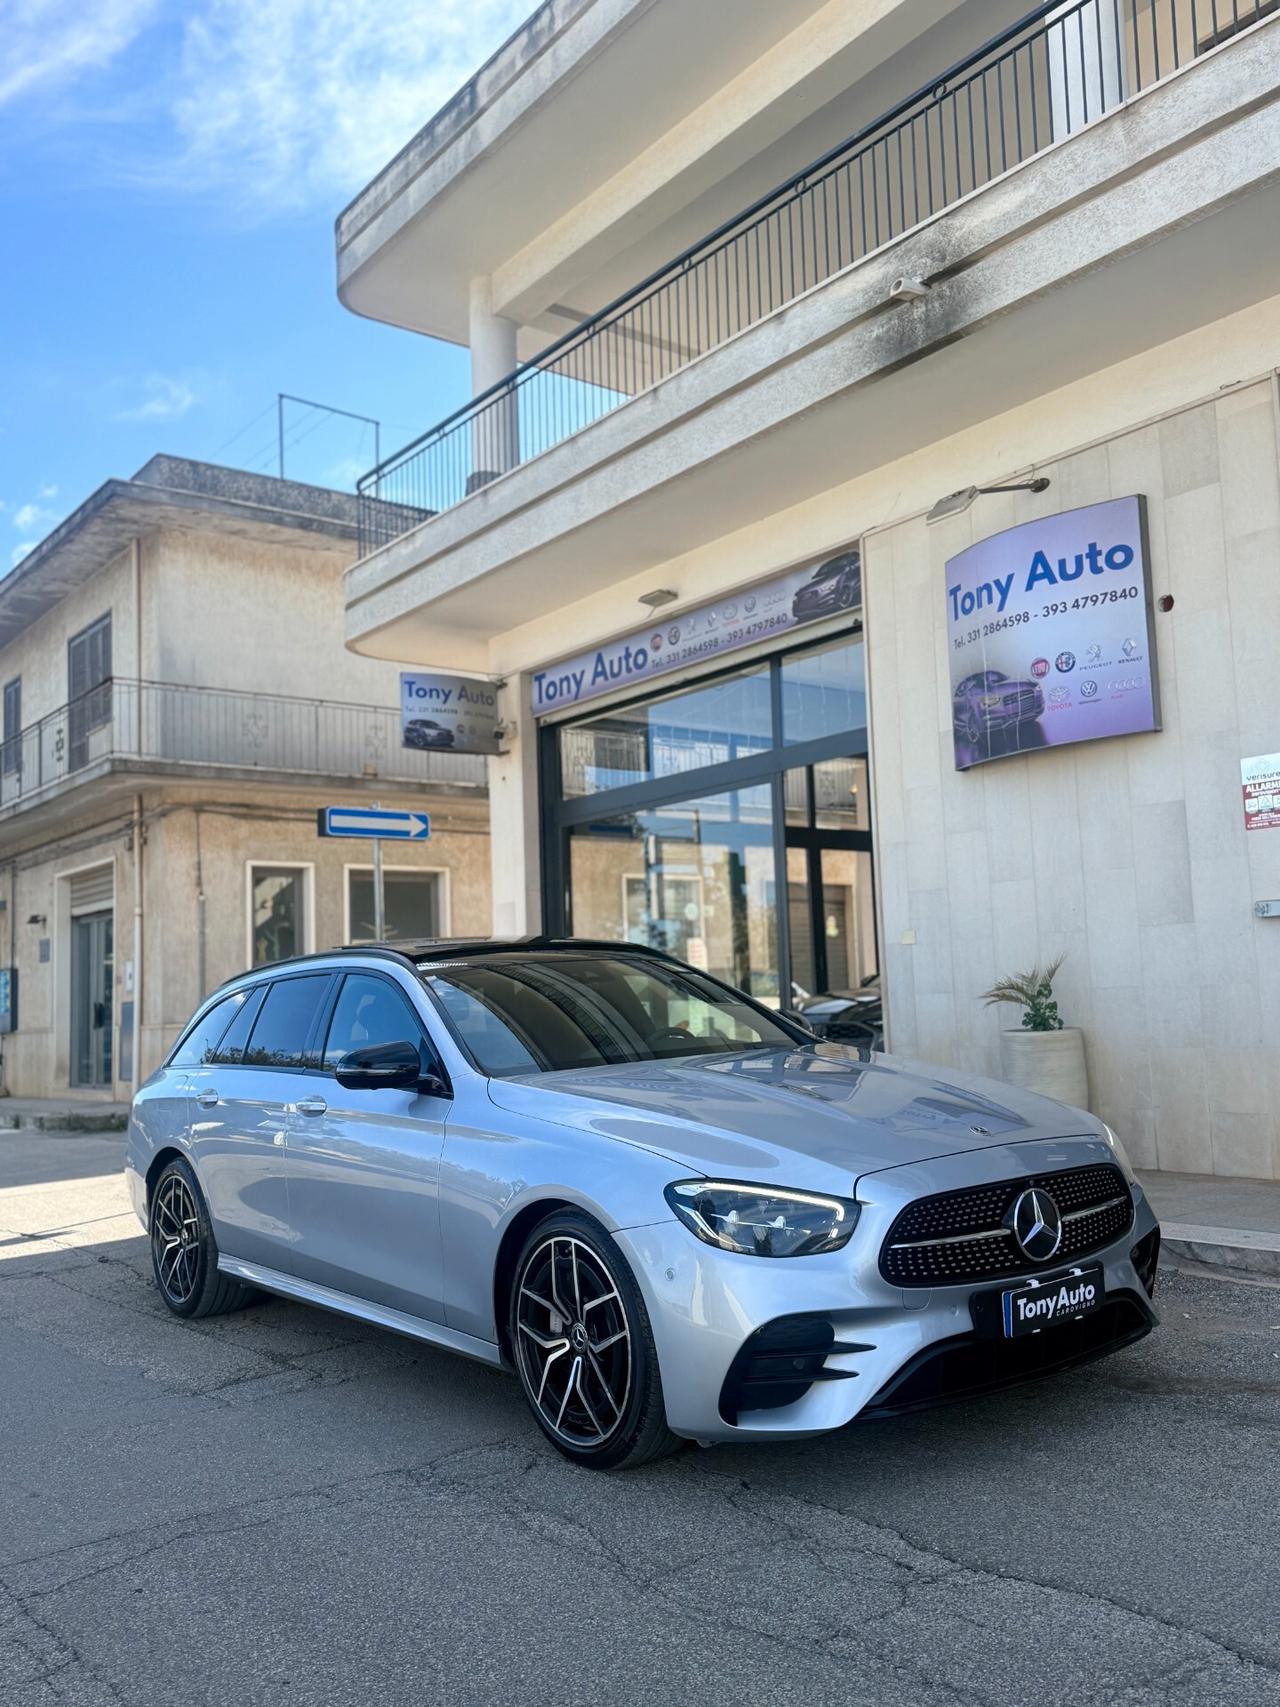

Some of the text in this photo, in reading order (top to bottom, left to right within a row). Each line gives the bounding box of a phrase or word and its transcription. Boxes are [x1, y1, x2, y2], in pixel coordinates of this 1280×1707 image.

[949, 542, 1134, 621] Tony Auto
[666, 653, 680, 665] 331
[682, 637, 719, 658] 2864598
[728, 628, 744, 643] 393
[746, 613, 788, 635] 4797840
[967, 628, 980, 643] 331
[983, 611, 1030, 637] 2864598
[1042, 601, 1068, 618] 393
[1072, 586, 1139, 610] 4797840
[404, 681, 495, 706] Tony Auto
[534, 646, 649, 704] Tony Auto
[1017, 1283, 1095, 1320] TonyAuto
[1056, 1299, 1096, 1316] CAROVIGNO
